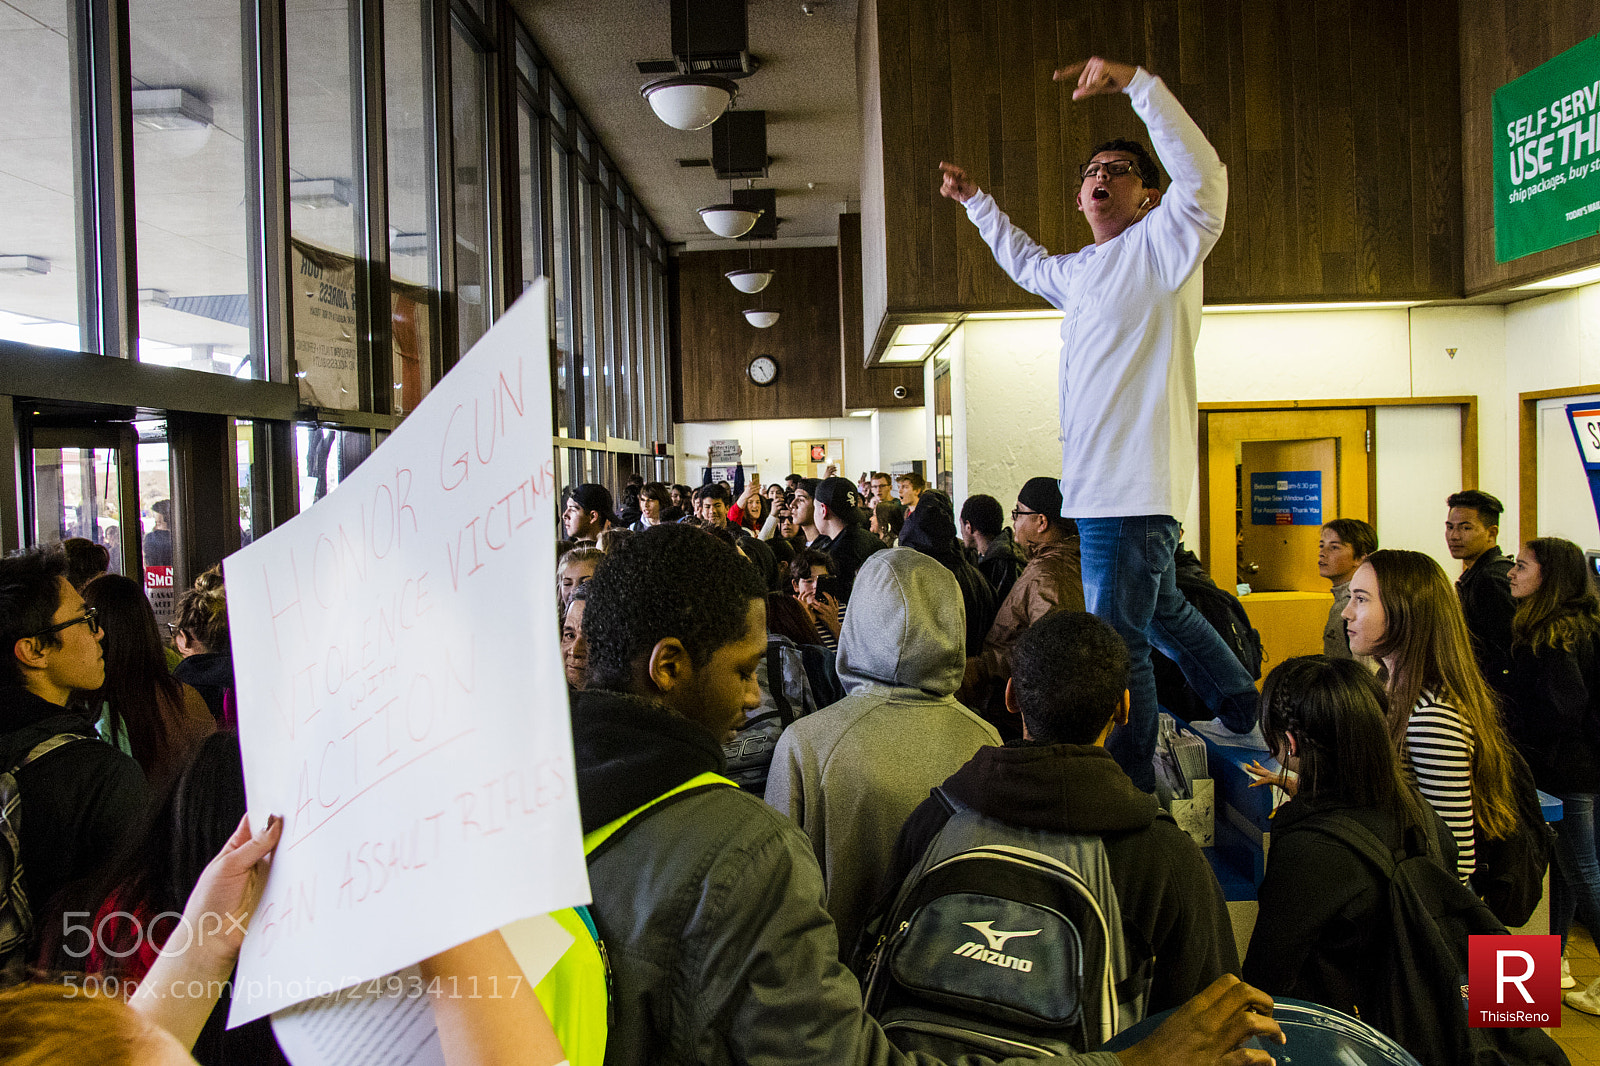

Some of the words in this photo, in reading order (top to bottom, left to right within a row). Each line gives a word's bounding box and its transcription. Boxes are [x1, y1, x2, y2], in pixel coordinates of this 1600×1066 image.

[1507, 107, 1547, 148] SELF
[1550, 79, 1600, 129] SERV
[1509, 132, 1555, 186] USE
[1508, 188, 1528, 204] ship
[1527, 173, 1567, 200] packages,
[1568, 163, 1589, 180] buy
[262, 465, 419, 662] HONOR
[440, 355, 524, 492] GUN
[1304, 494, 1319, 502] Clerk
[271, 571, 433, 742] VIOLENCE
[447, 459, 556, 593] VICTIMS
[293, 632, 477, 838] ACTION
[336, 810, 446, 910] ASSAULT
[453, 755, 567, 843] RIFLES
